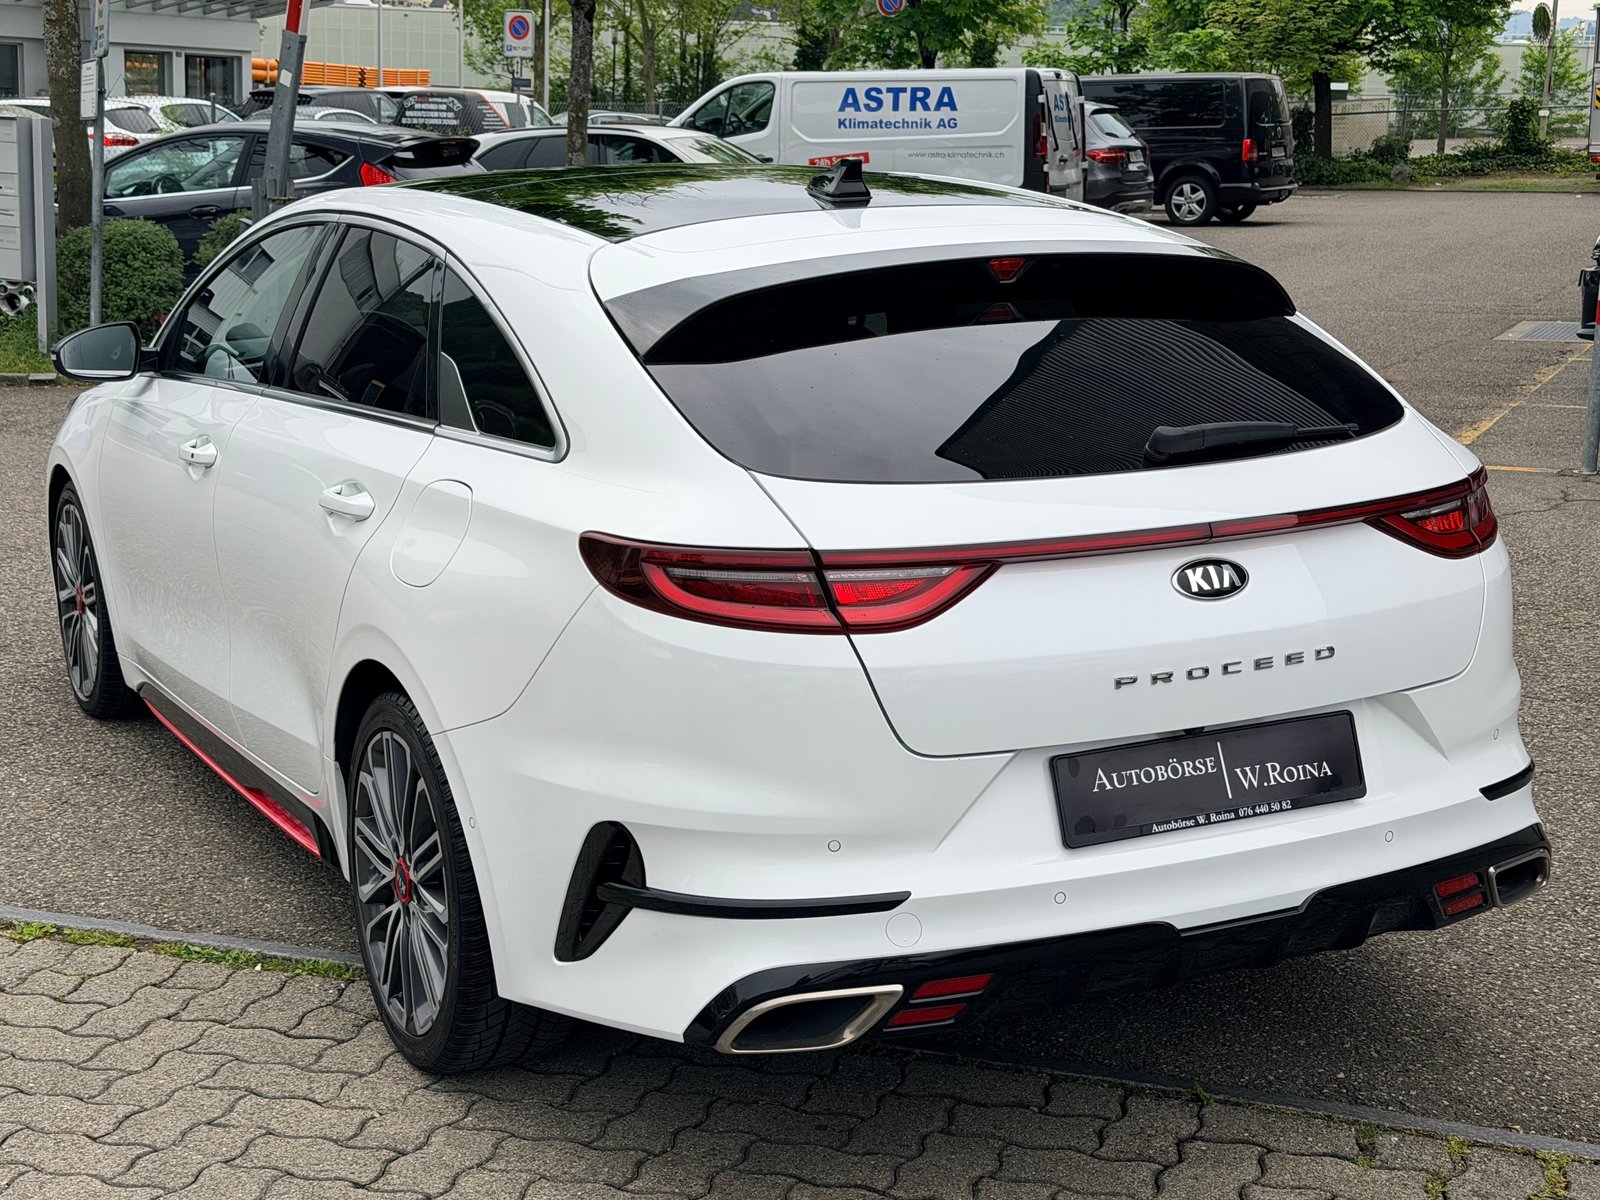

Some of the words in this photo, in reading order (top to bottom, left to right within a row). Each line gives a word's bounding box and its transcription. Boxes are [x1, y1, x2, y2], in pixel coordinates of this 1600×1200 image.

[837, 86, 958, 113] ASTRA
[837, 117, 932, 129] Klimatechnik
[936, 117, 958, 129] AG
[907, 150, 1005, 159] www.astra-klimatechnik.ch
[1183, 563, 1242, 593] KIA
[1114, 645, 1336, 690] PROCEED
[1151, 819, 1195, 833] Autobörse
[1196, 814, 1209, 825] W.
[1210, 811, 1236, 823] Roina
[1238, 806, 1254, 817] 076
[1255, 803, 1269, 814] 440
[1271, 801, 1281, 812] 50
[1282, 799, 1292, 809] 82
